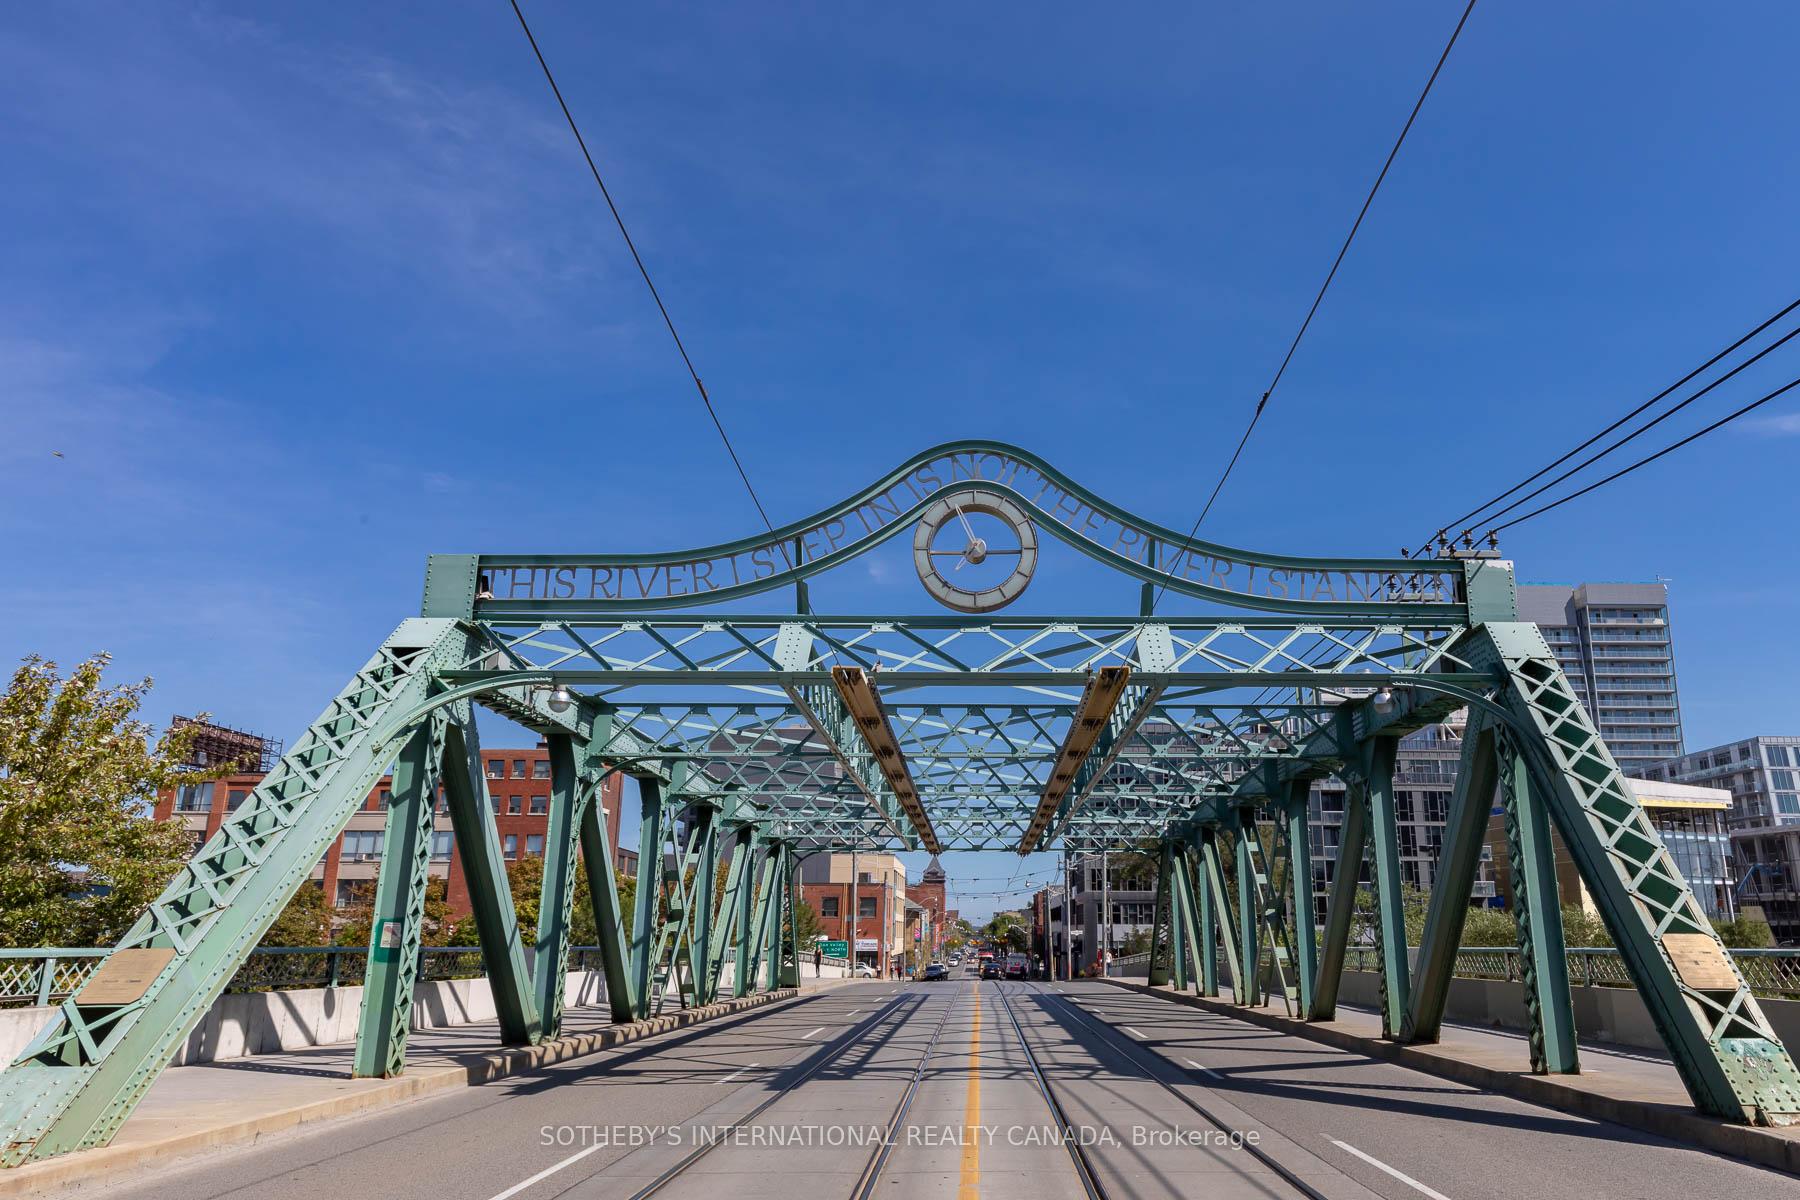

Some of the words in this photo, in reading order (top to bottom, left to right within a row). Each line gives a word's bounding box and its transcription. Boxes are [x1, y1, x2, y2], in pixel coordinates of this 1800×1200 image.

[481, 567, 577, 600] THIS
[589, 559, 721, 600] RIVER
[727, 555, 742, 586] I
[752, 519, 846, 581] STEP
[854, 490, 904, 535] IN
[901, 463, 942, 502] IS
[949, 452, 1031, 487] NOT
[1032, 473, 1108, 542] THE
[1111, 525, 1233, 592] RIVER
[1246, 561, 1257, 594] I
[1266, 568, 1406, 602] STAND
[1418, 570, 1460, 603] IN
